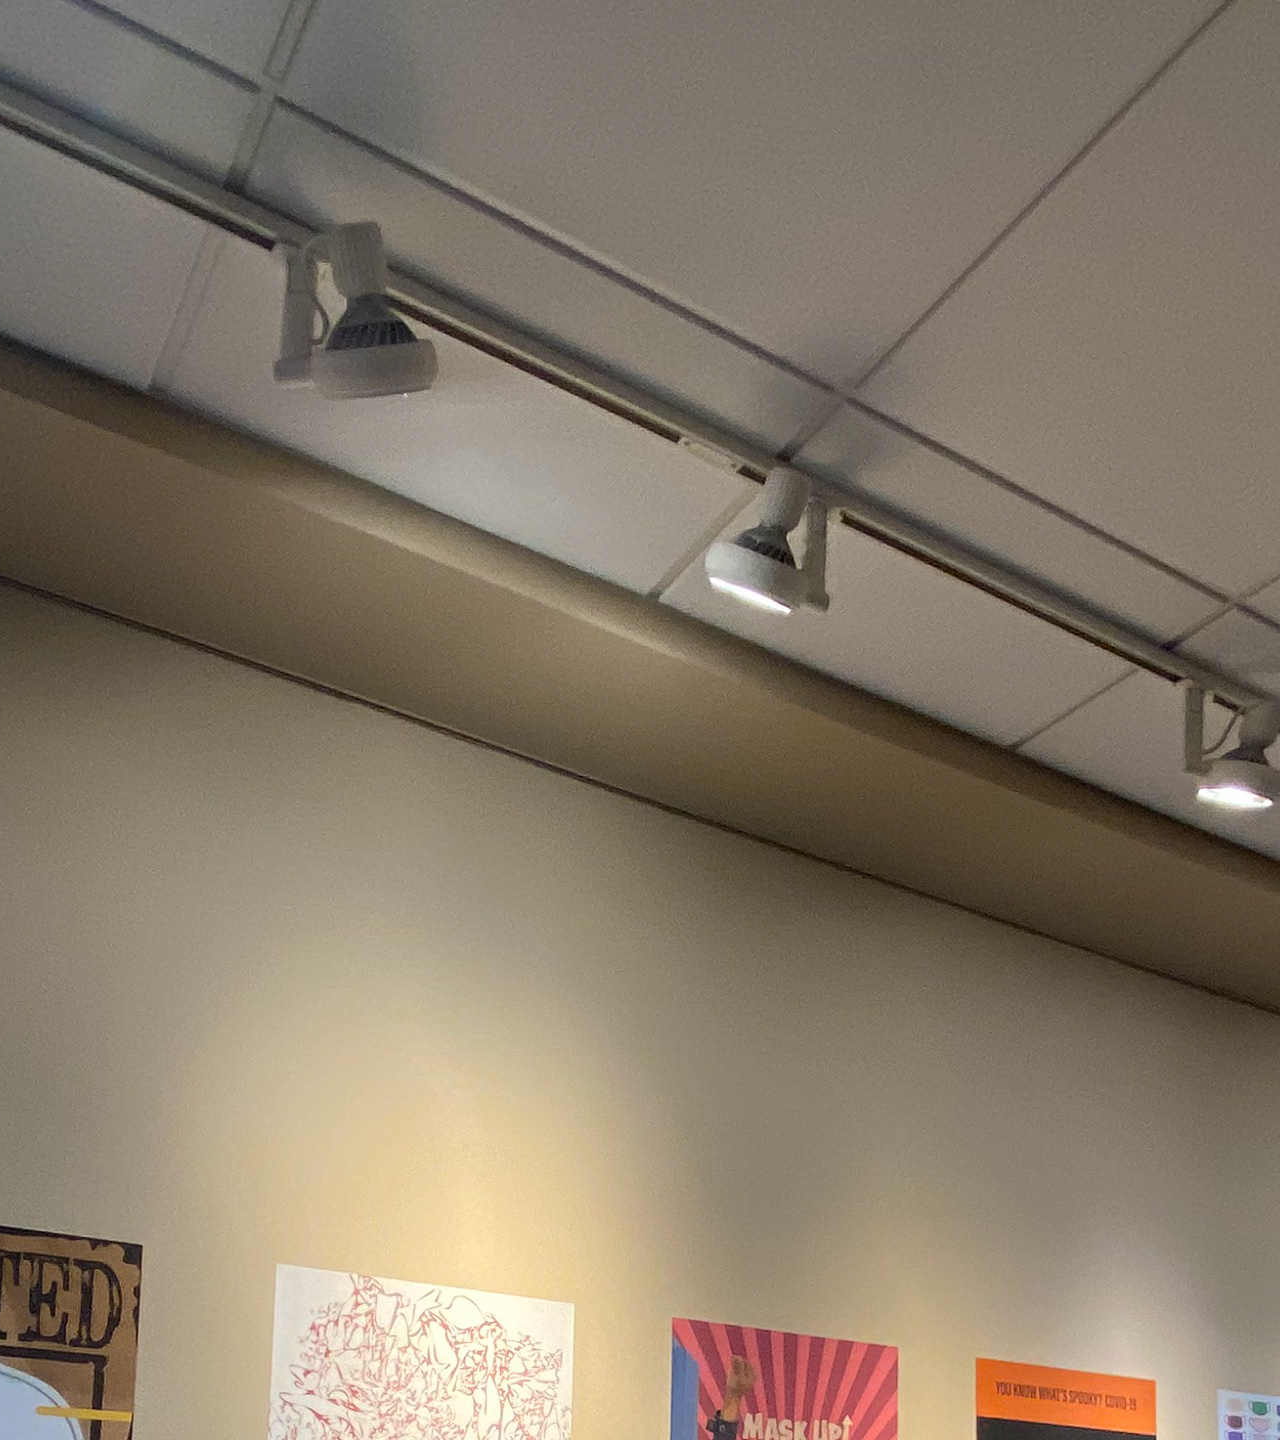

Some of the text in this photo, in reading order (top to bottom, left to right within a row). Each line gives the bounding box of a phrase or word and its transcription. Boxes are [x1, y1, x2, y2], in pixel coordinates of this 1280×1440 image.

[995, 1381, 1012, 1396] YOU
[1012, 1383, 1037, 1399] KNOW
[1104, 1394, 1137, 1411] COVID-19
